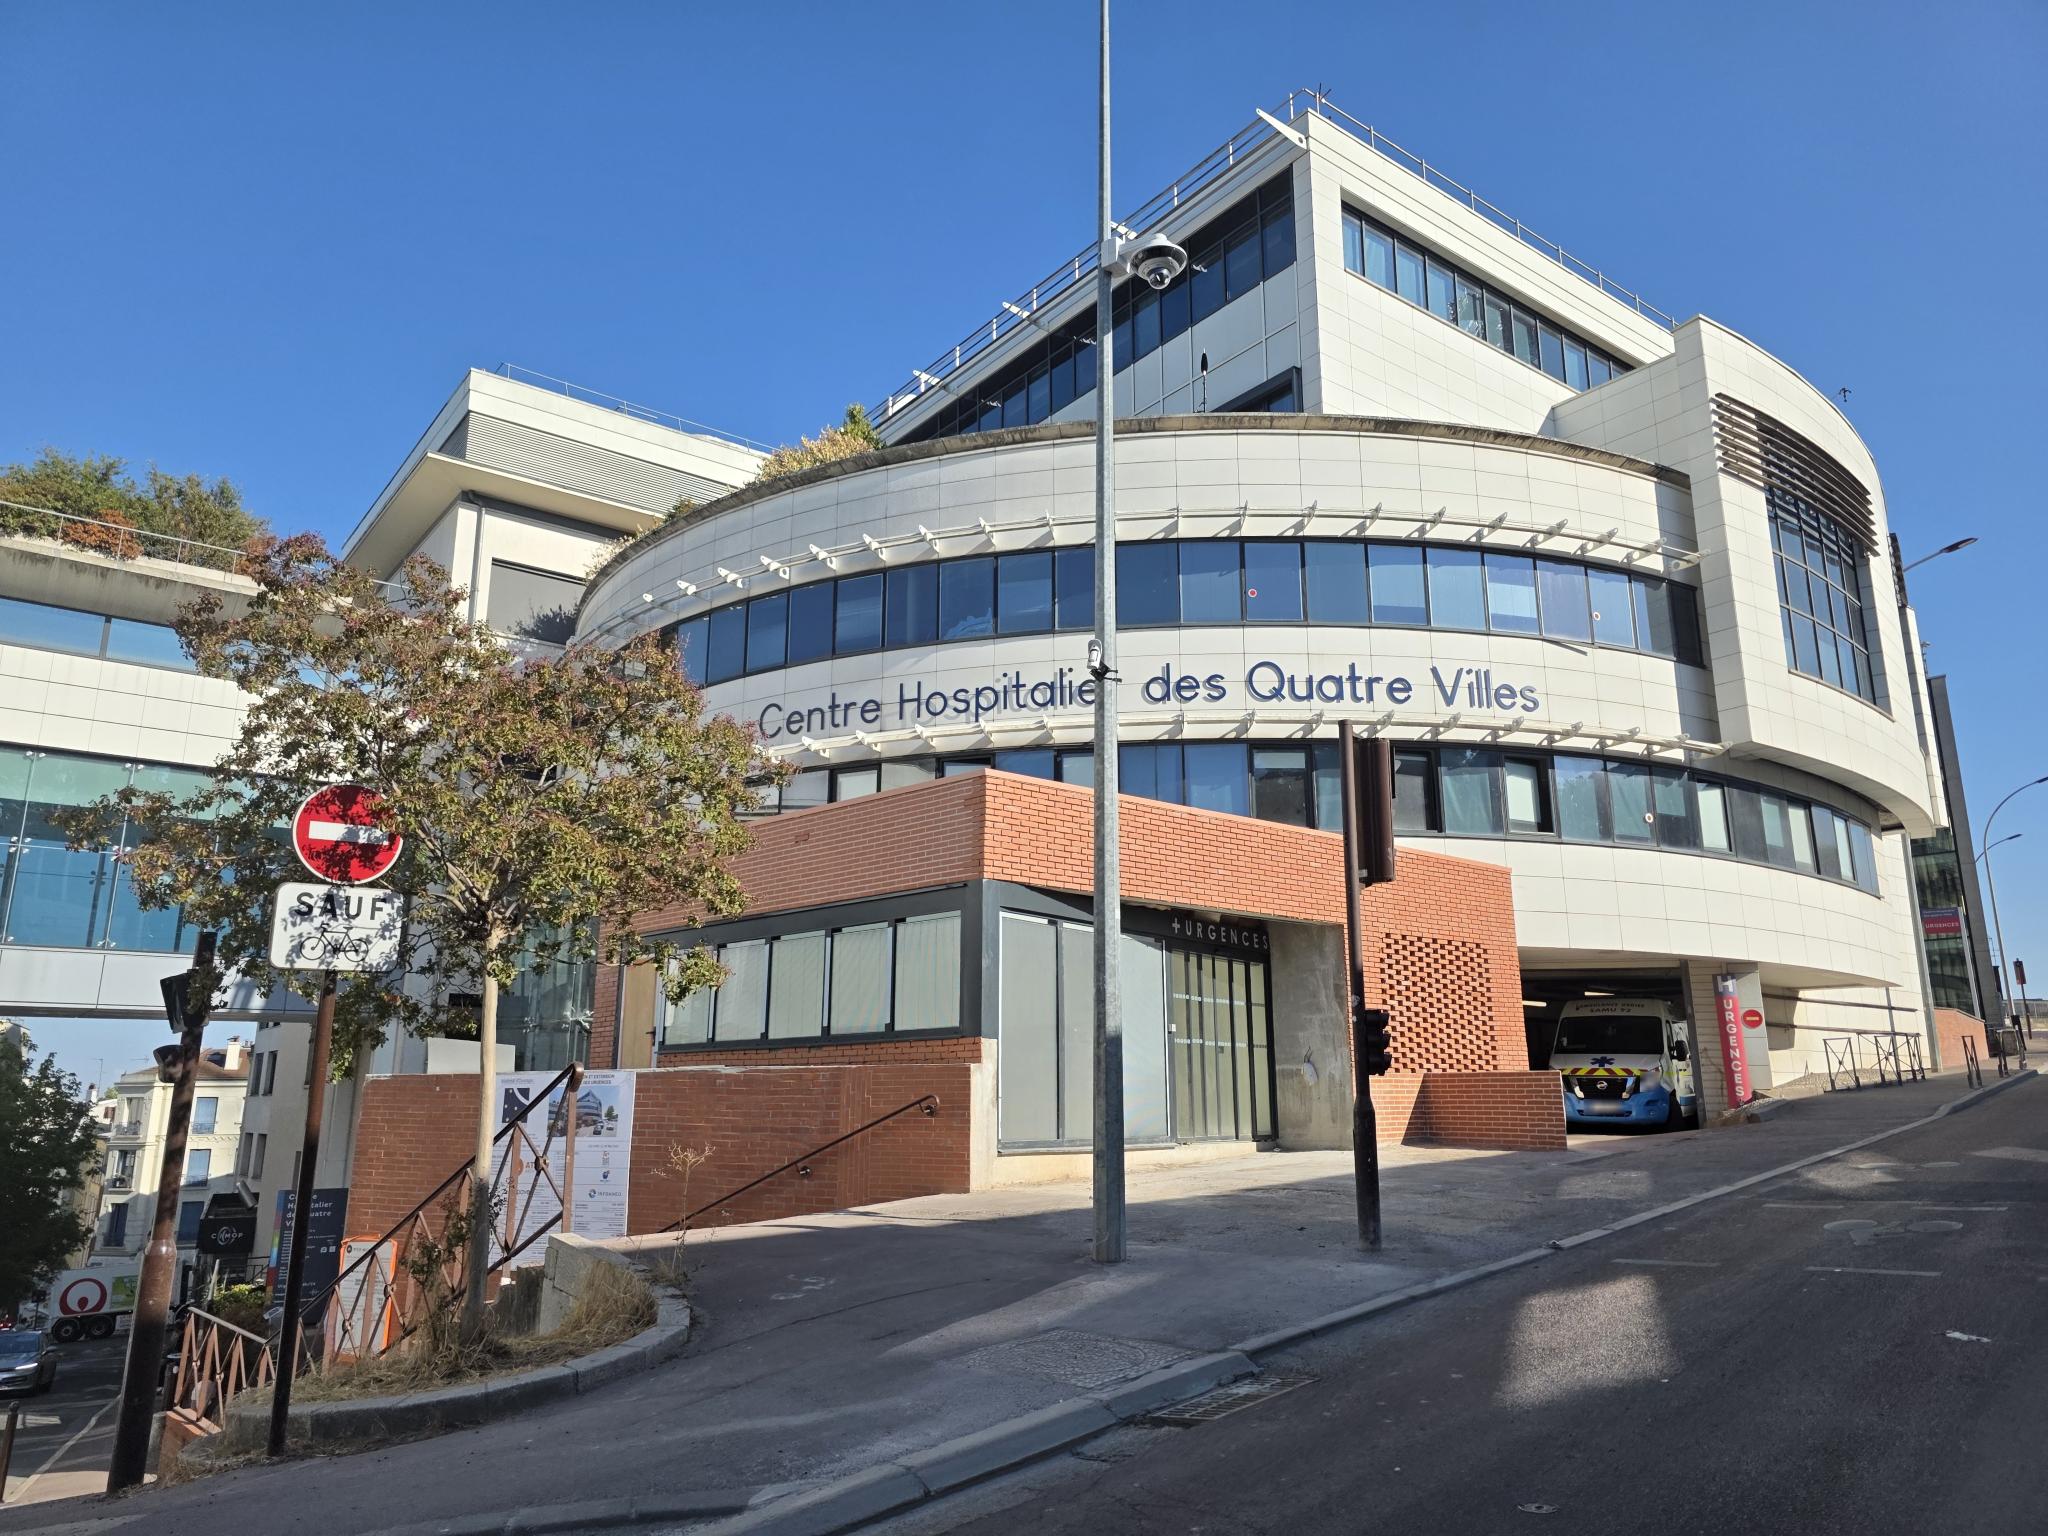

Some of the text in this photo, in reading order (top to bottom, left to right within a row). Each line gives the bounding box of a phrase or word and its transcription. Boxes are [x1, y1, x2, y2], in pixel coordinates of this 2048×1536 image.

[759, 660, 1540, 739] Centre Hospitalie des Quatre Villes
[294, 891, 387, 921] SAUF
[1723, 999, 1745, 1097] URGENCES
